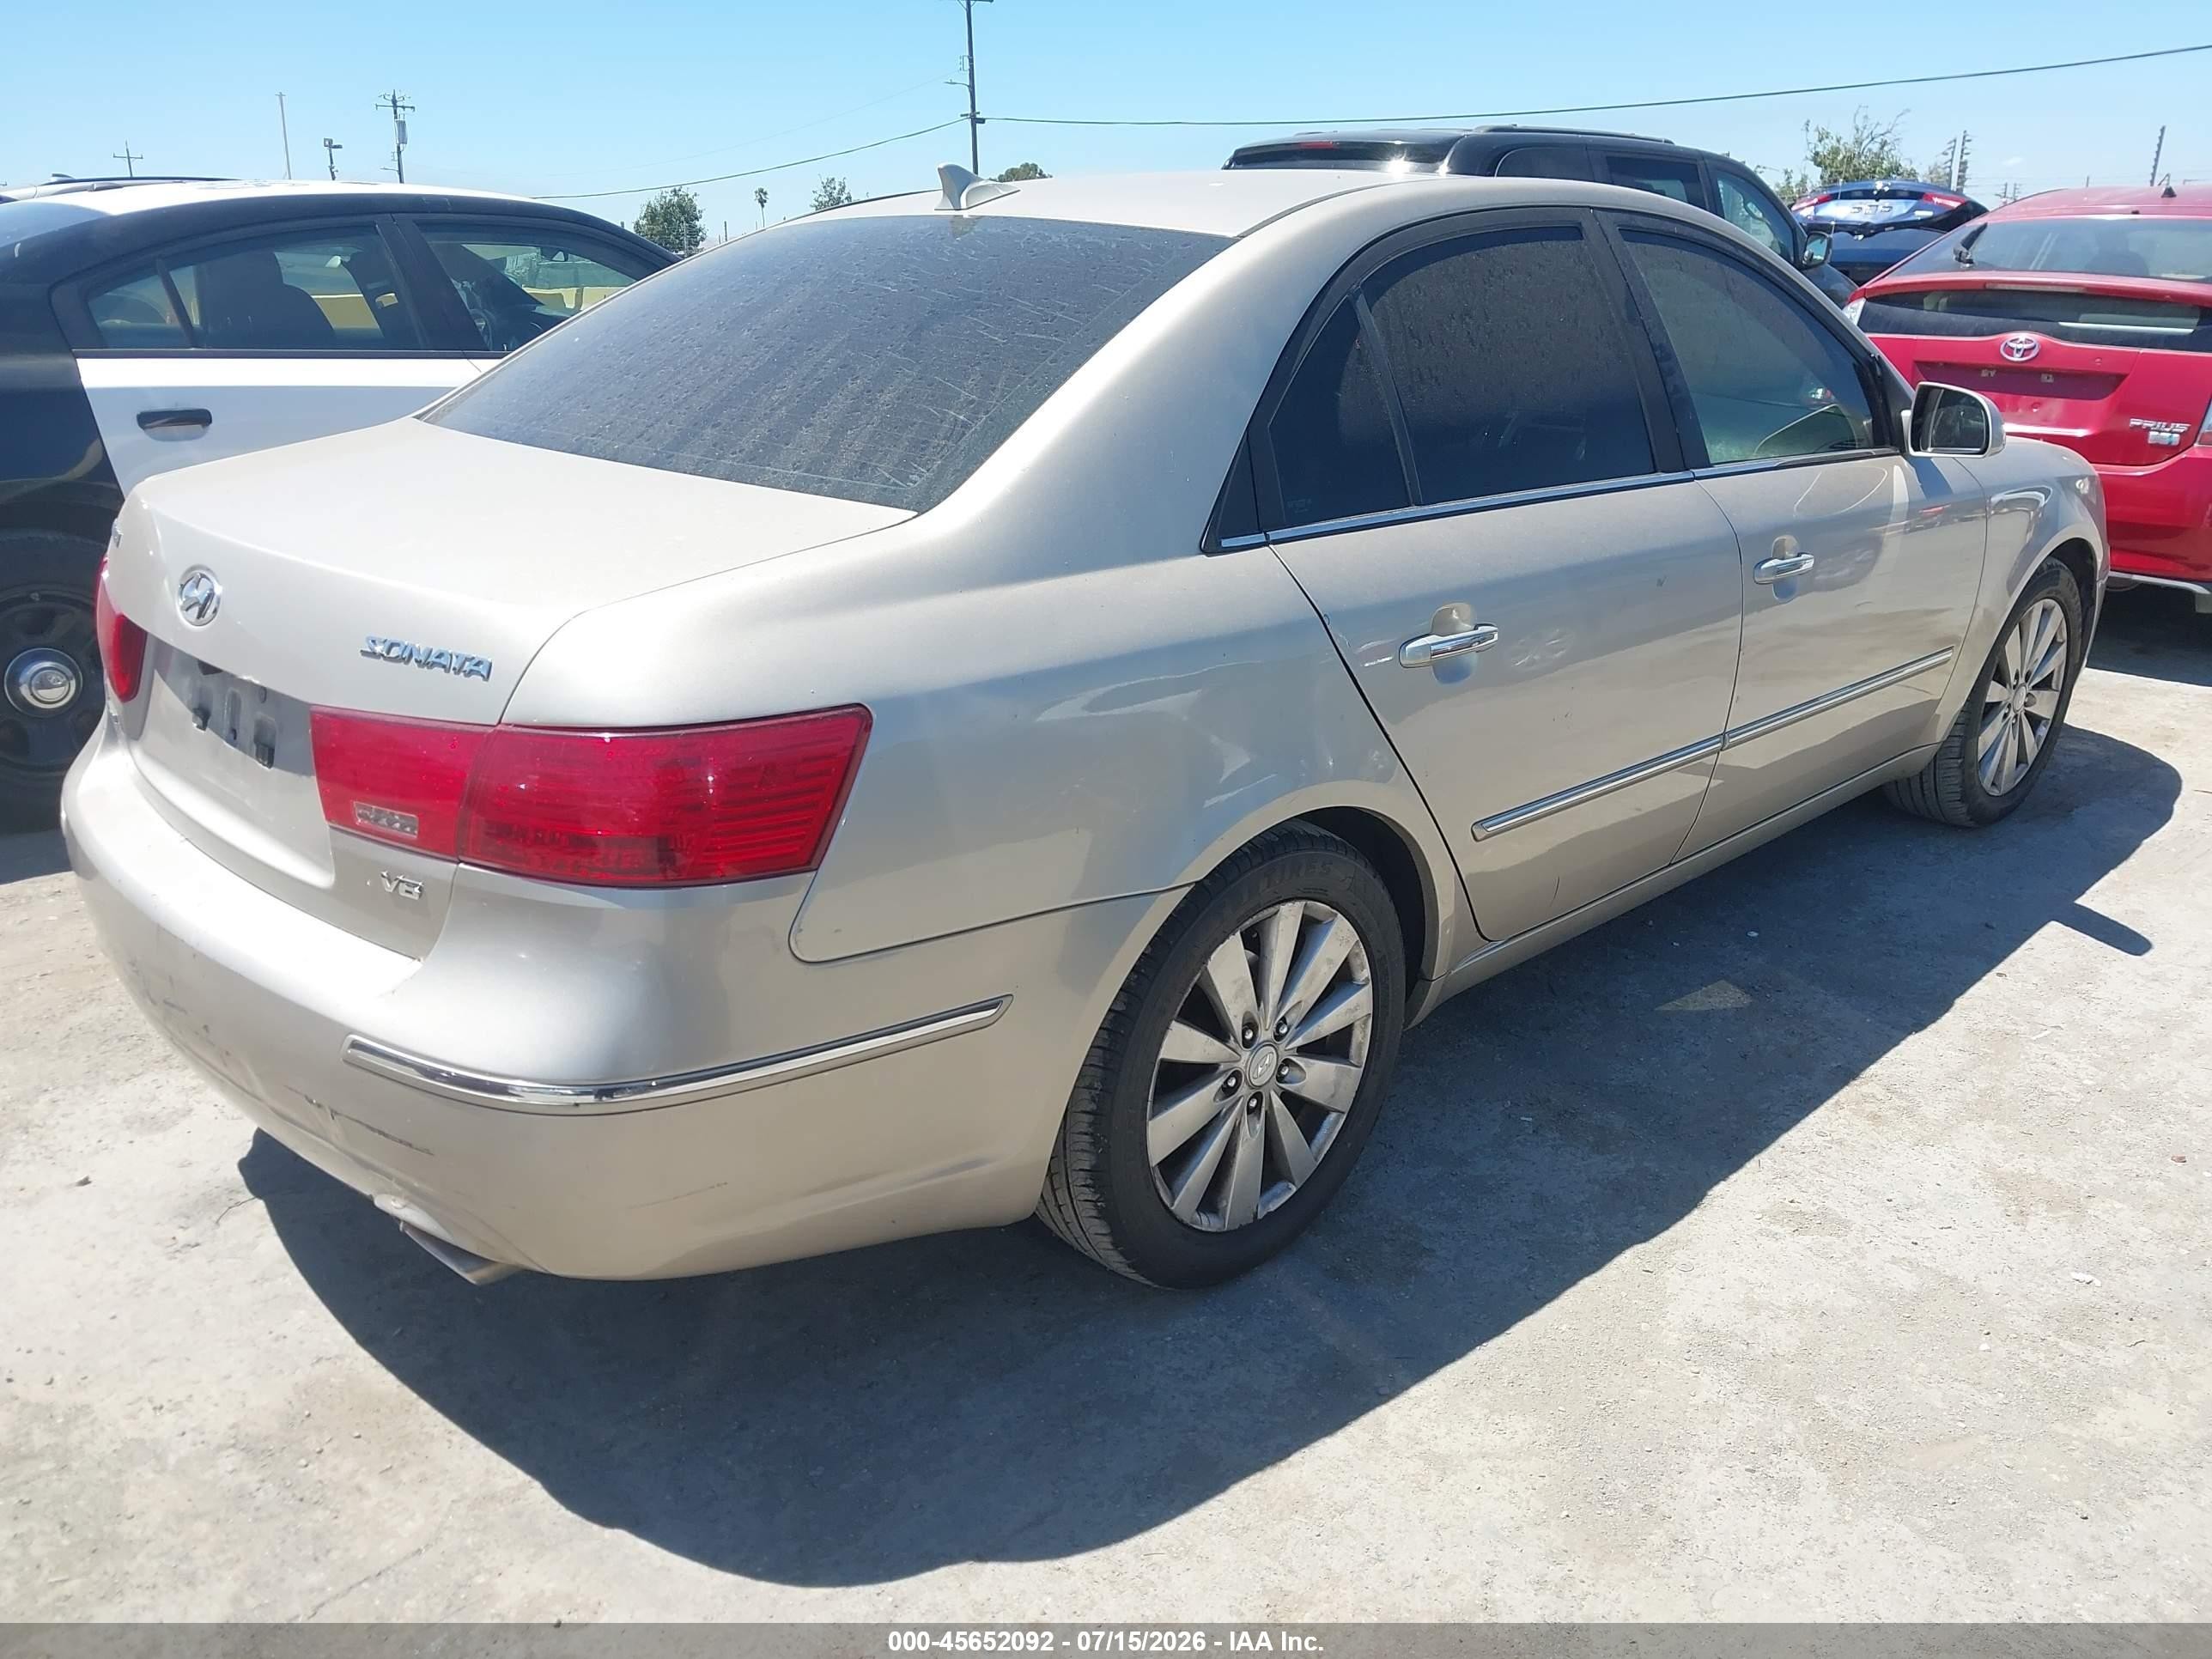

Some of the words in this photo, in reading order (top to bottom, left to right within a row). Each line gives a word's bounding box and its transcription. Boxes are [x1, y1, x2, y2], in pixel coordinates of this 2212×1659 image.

[2130, 417, 2191, 434] PRIUS
[360, 635, 493, 682] SONATA
[380, 871, 424, 901] V6
